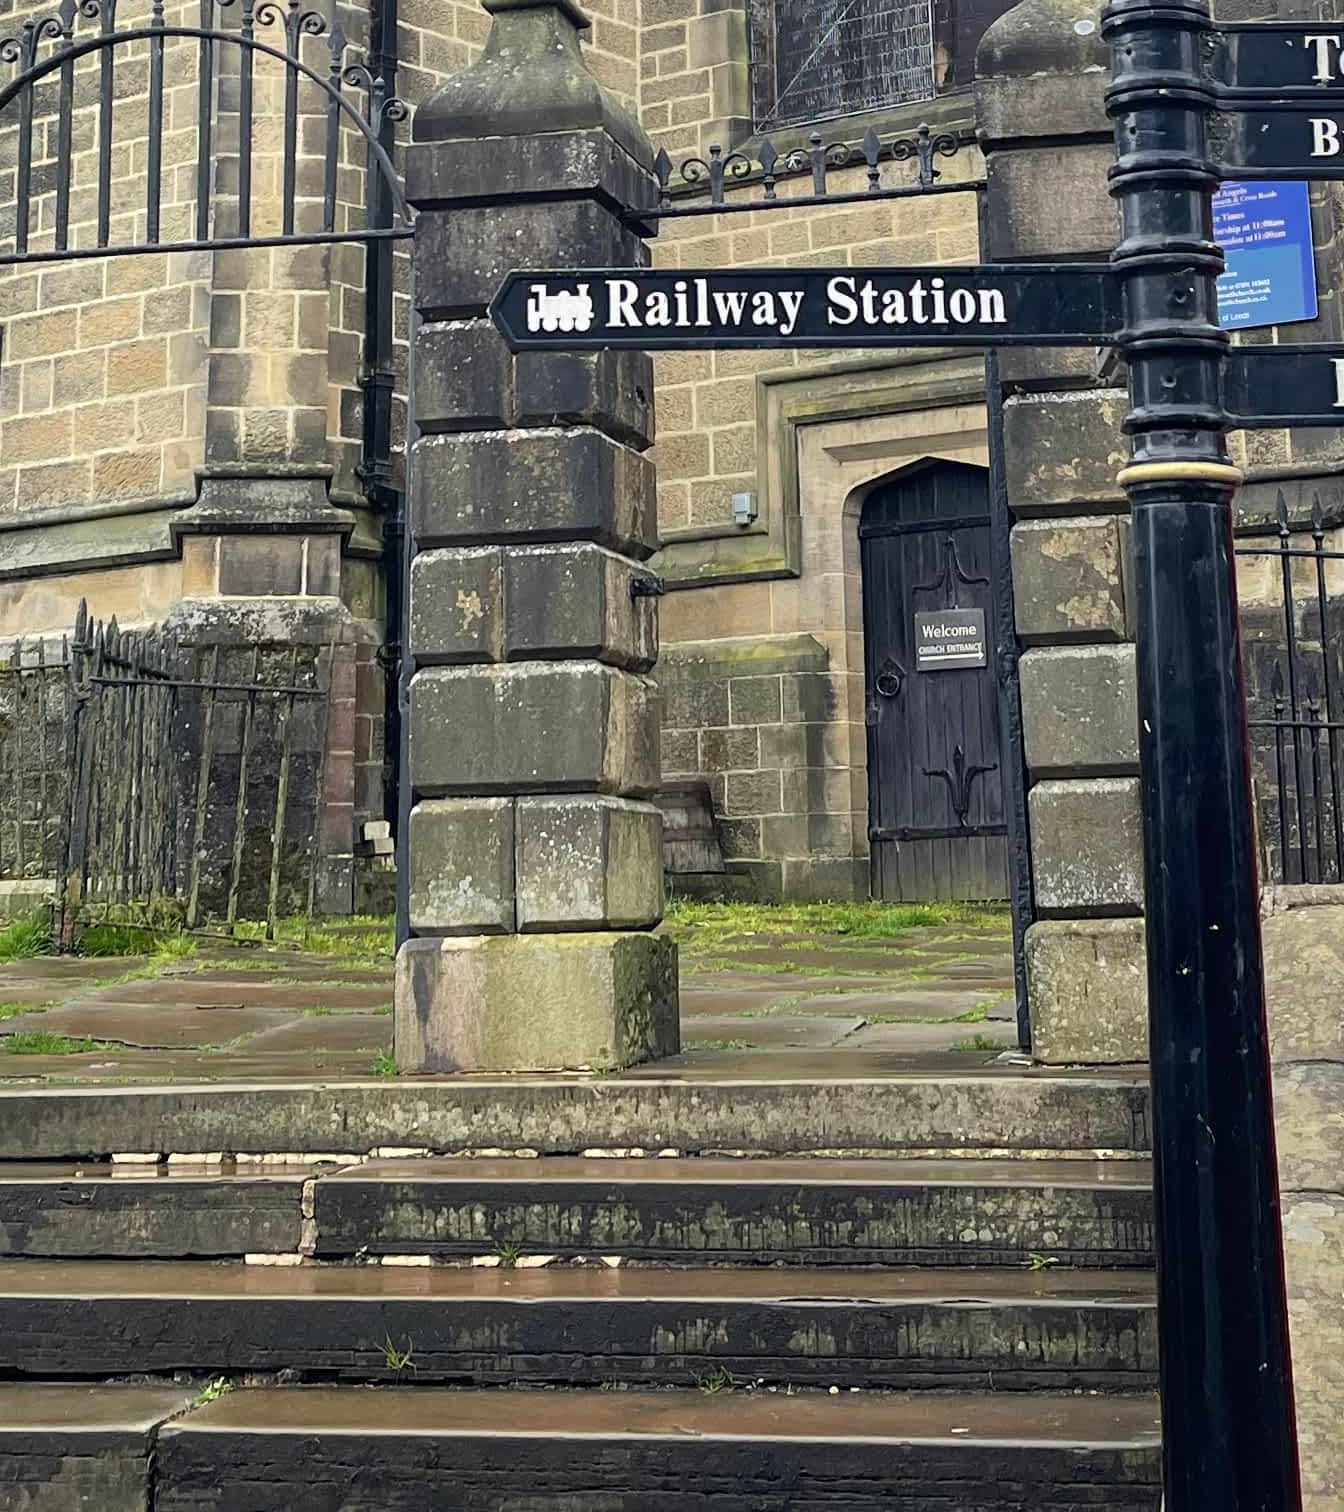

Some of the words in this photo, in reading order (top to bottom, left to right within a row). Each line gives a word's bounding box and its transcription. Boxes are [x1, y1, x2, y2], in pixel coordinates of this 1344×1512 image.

[605, 279, 805, 335] Railway
[826, 276, 1008, 325] Station
[922, 624, 977, 638] Welcome
